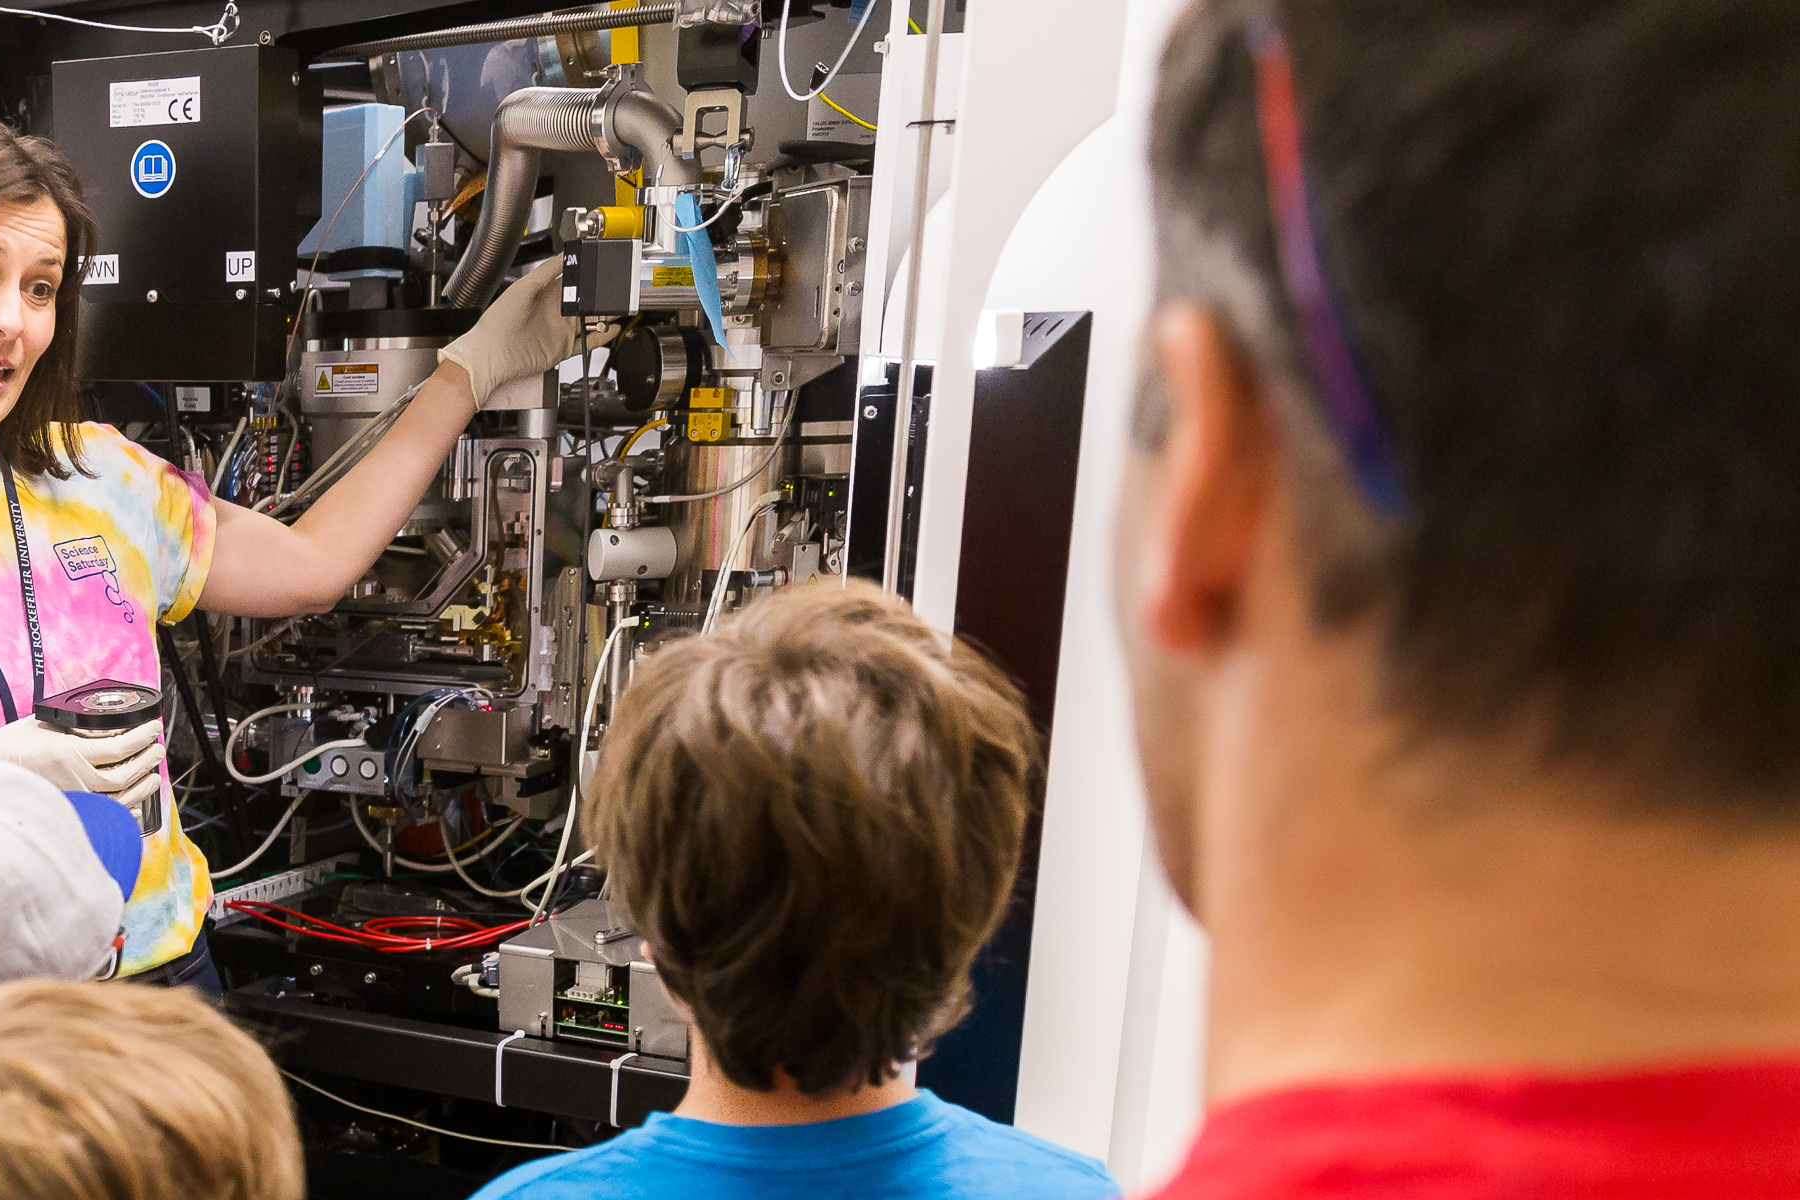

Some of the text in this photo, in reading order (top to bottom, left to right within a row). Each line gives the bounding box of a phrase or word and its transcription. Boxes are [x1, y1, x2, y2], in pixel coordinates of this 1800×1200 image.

[168, 97, 193, 121] CE
[78, 260, 115, 278] WN
[228, 257, 252, 276] UP
[60, 545, 99, 560] Science
[67, 554, 109, 572] Saturday
[9, 500, 45, 677] THE ROCKEFELLER UNIVERSITY
